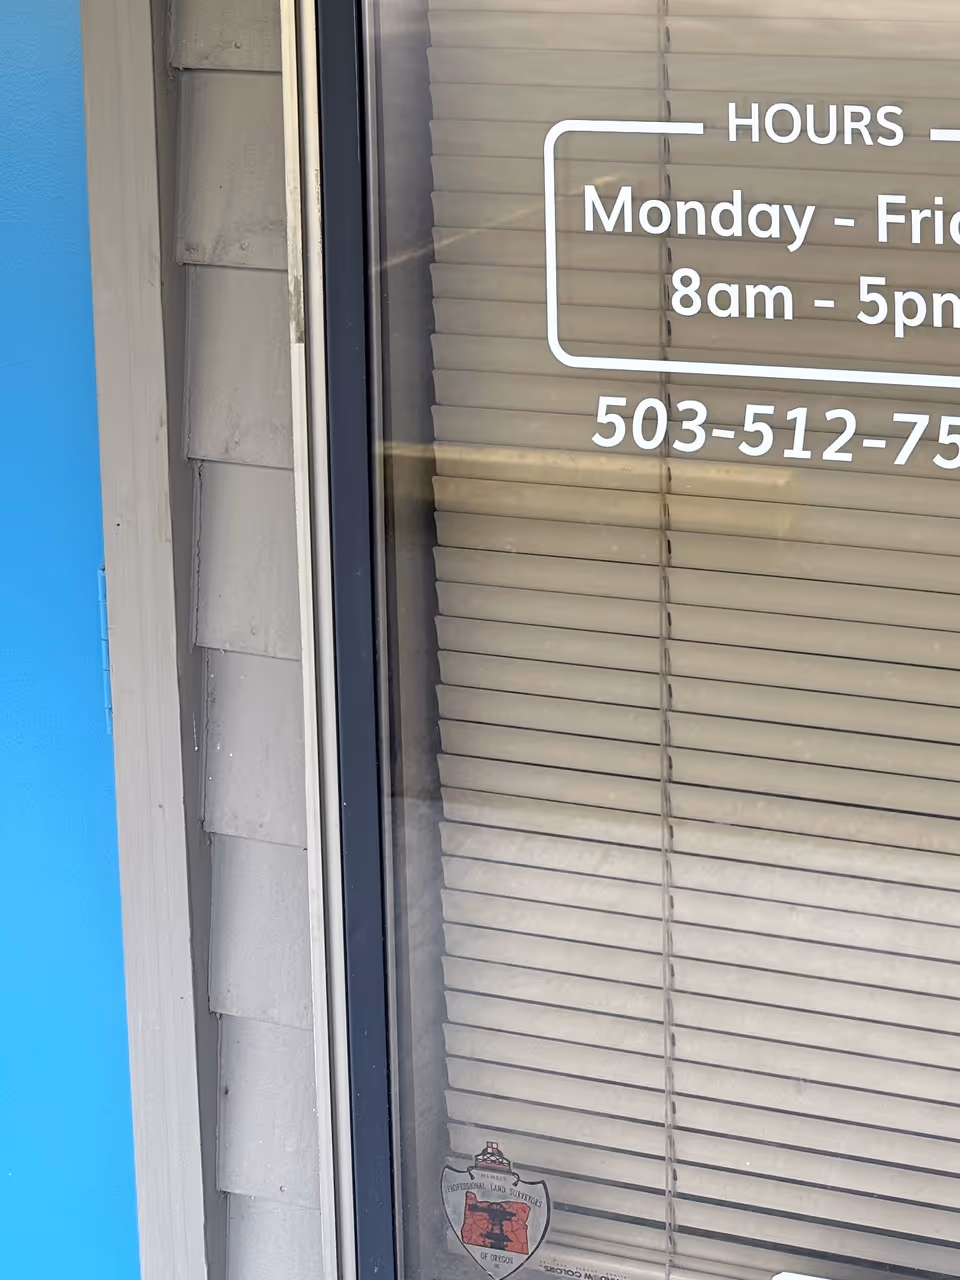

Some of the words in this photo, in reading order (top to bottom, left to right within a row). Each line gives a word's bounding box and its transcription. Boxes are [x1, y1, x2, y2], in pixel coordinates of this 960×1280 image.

[727, 102, 905, 147] HOURS
[582, 184, 816, 253] Monday
[834, 219, 855, 227] -
[670, 267, 794, 320] 8am
[814, 299, 835, 308] -
[447, 1182, 487, 1193] PROFESSIONAL
[490, 1183, 507, 1194] LAND
[509, 1188, 543, 1208] SURVEYORS
[480, 1252, 489, 1261] OF
